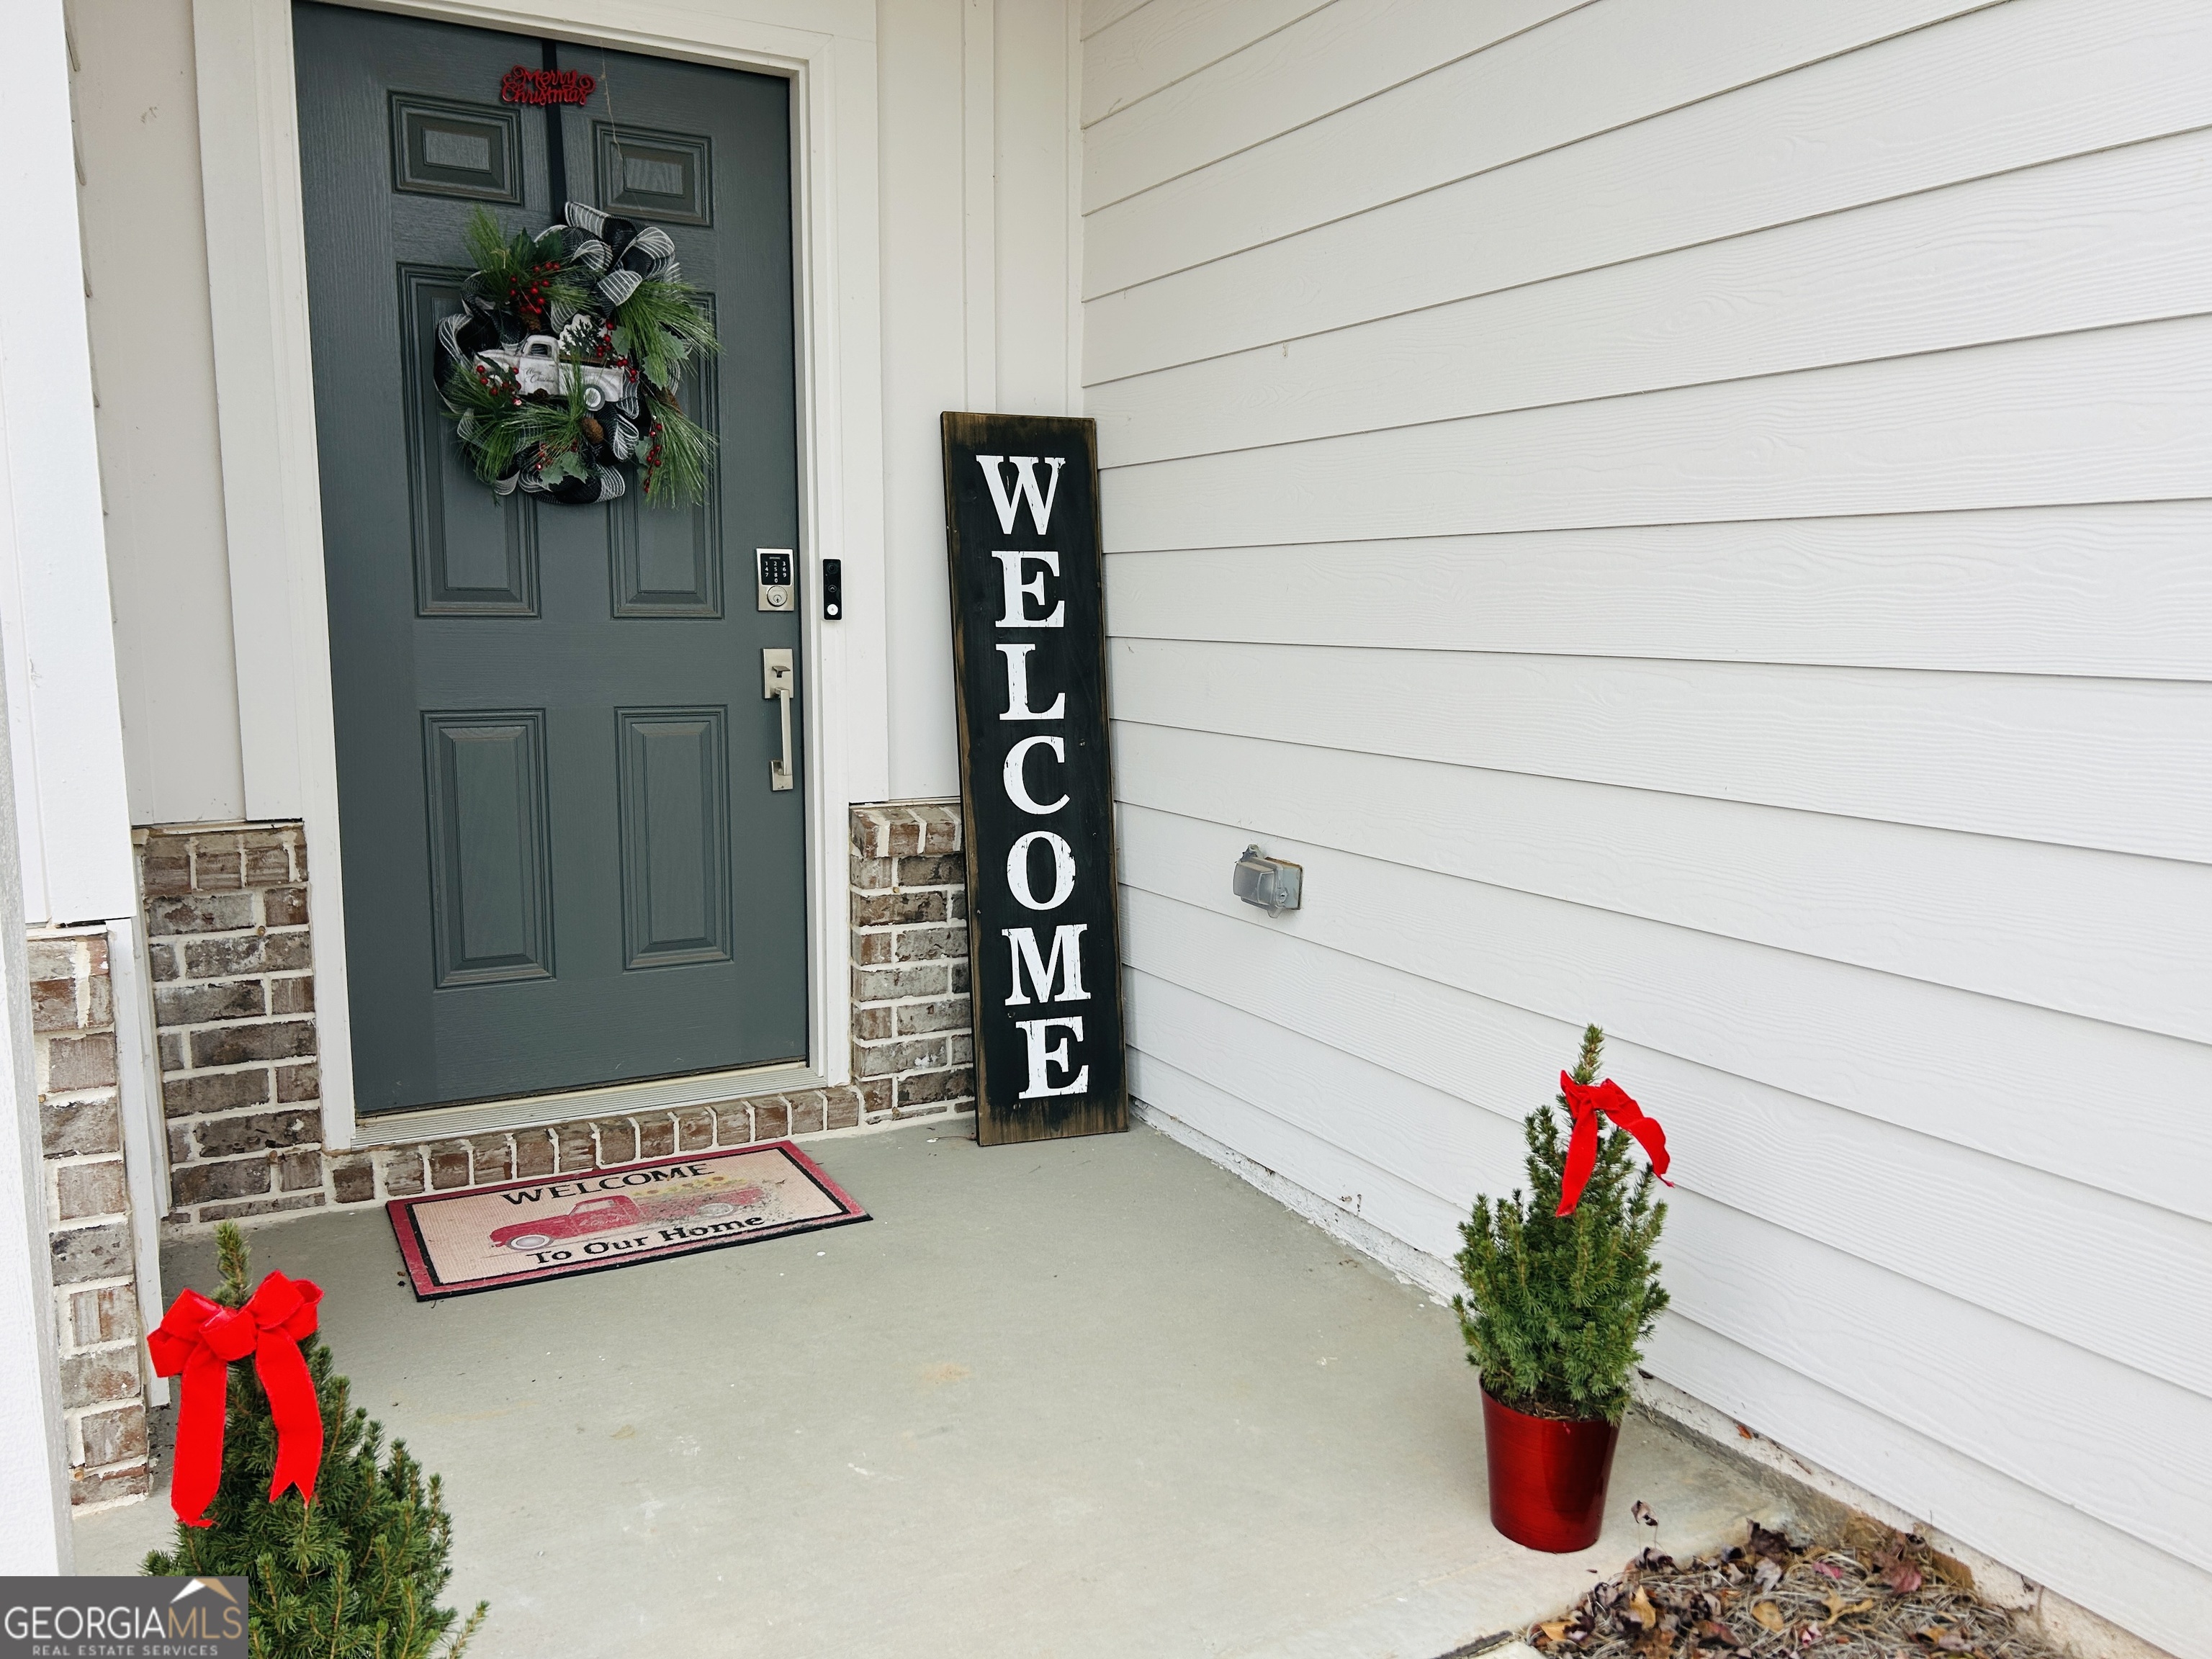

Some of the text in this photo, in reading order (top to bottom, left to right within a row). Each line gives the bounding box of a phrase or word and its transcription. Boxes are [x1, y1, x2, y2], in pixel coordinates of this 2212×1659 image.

[502, 74, 596, 106] Christmas
[512, 65, 579, 90] Merry
[976, 455, 1091, 1099] WELCOME
[500, 1163, 714, 1205] WELCOME
[526, 1215, 765, 1264] To Our Home
